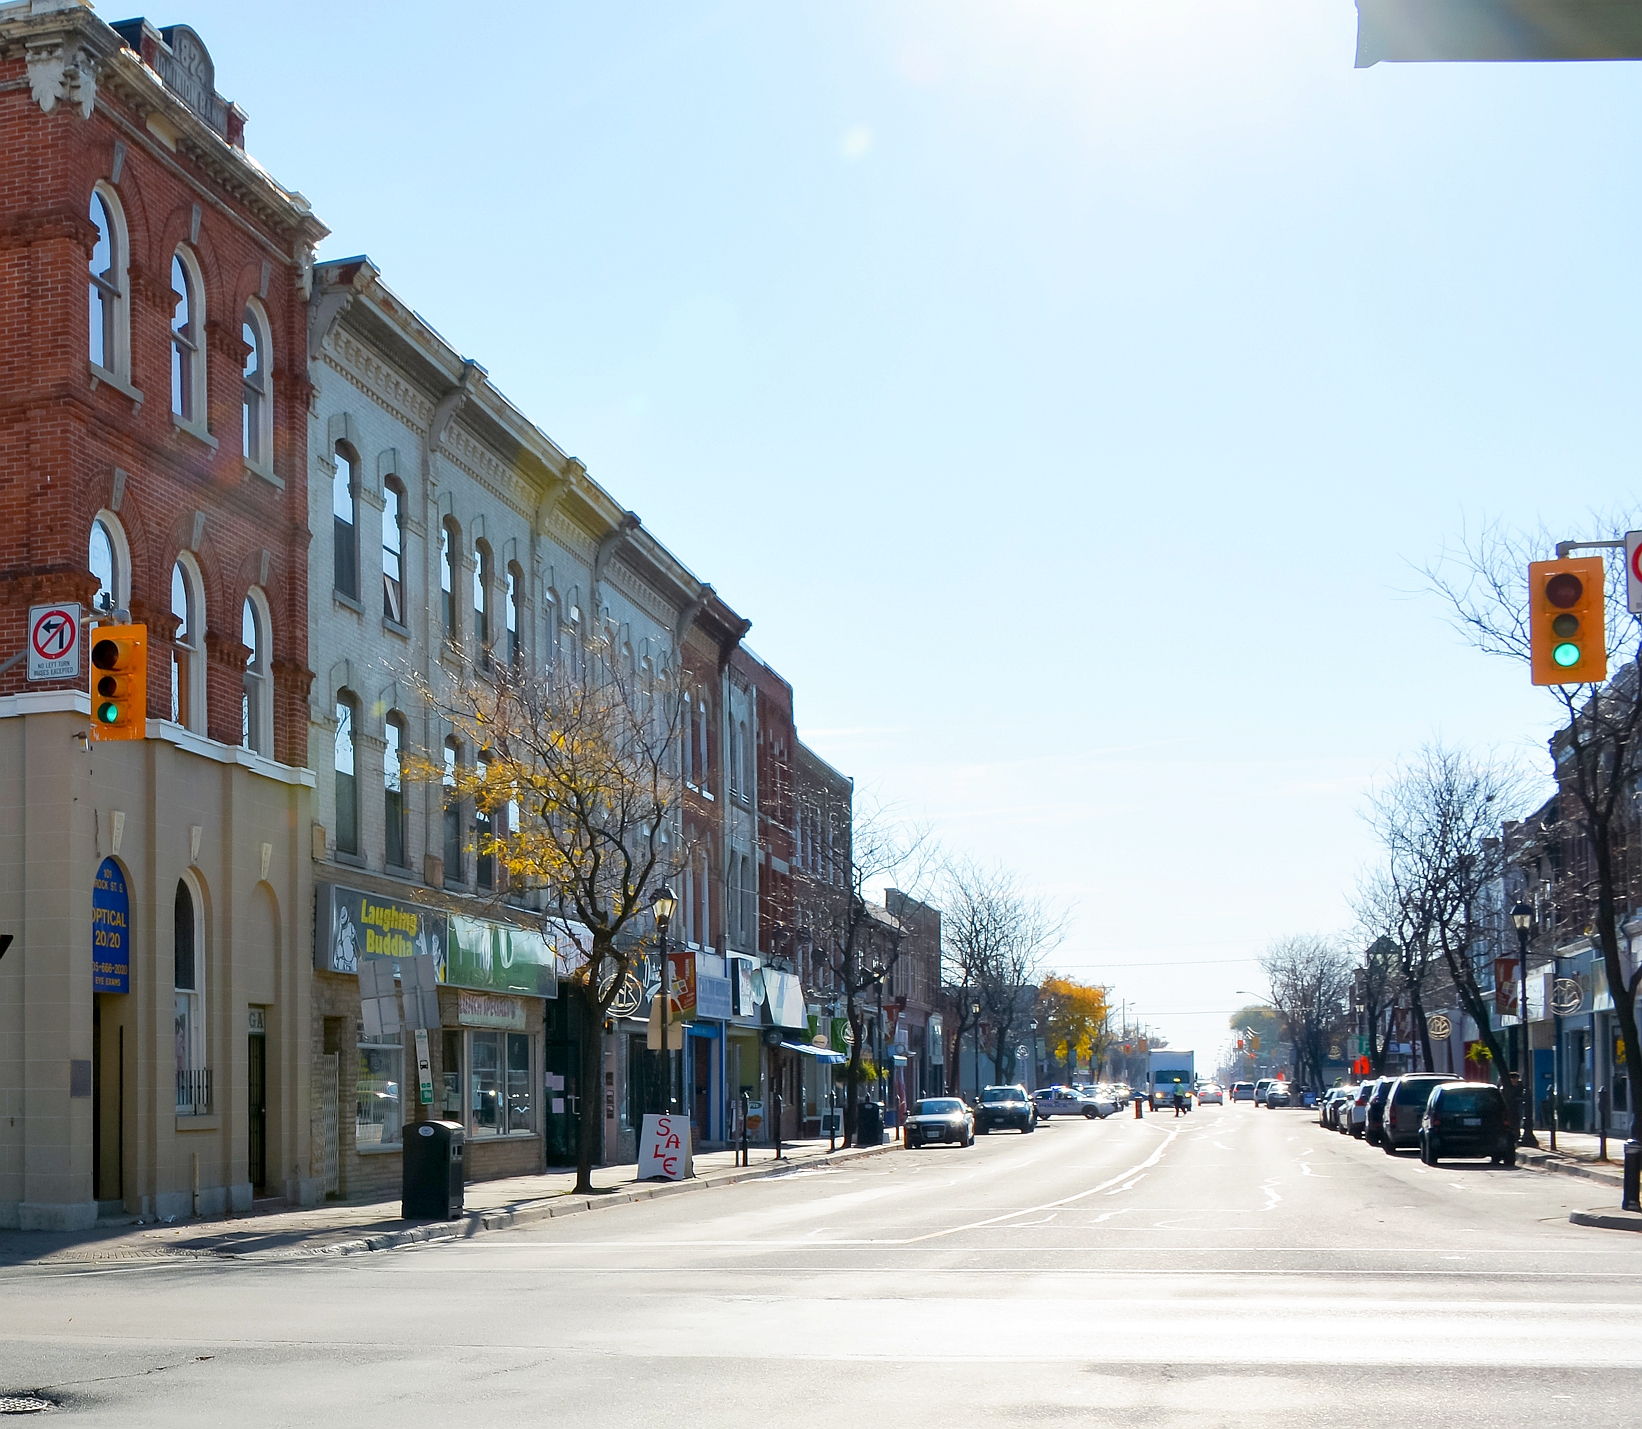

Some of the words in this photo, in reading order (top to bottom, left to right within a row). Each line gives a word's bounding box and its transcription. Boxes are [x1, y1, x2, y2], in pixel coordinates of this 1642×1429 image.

[50, 667, 73, 675] EXCEPTED
[361, 898, 417, 937] Laughing
[95, 929, 121, 949] 20/20
[366, 928, 413, 957] Buddha
[95, 976, 104, 985] EYE
[653, 1117, 681, 1176] SALE
